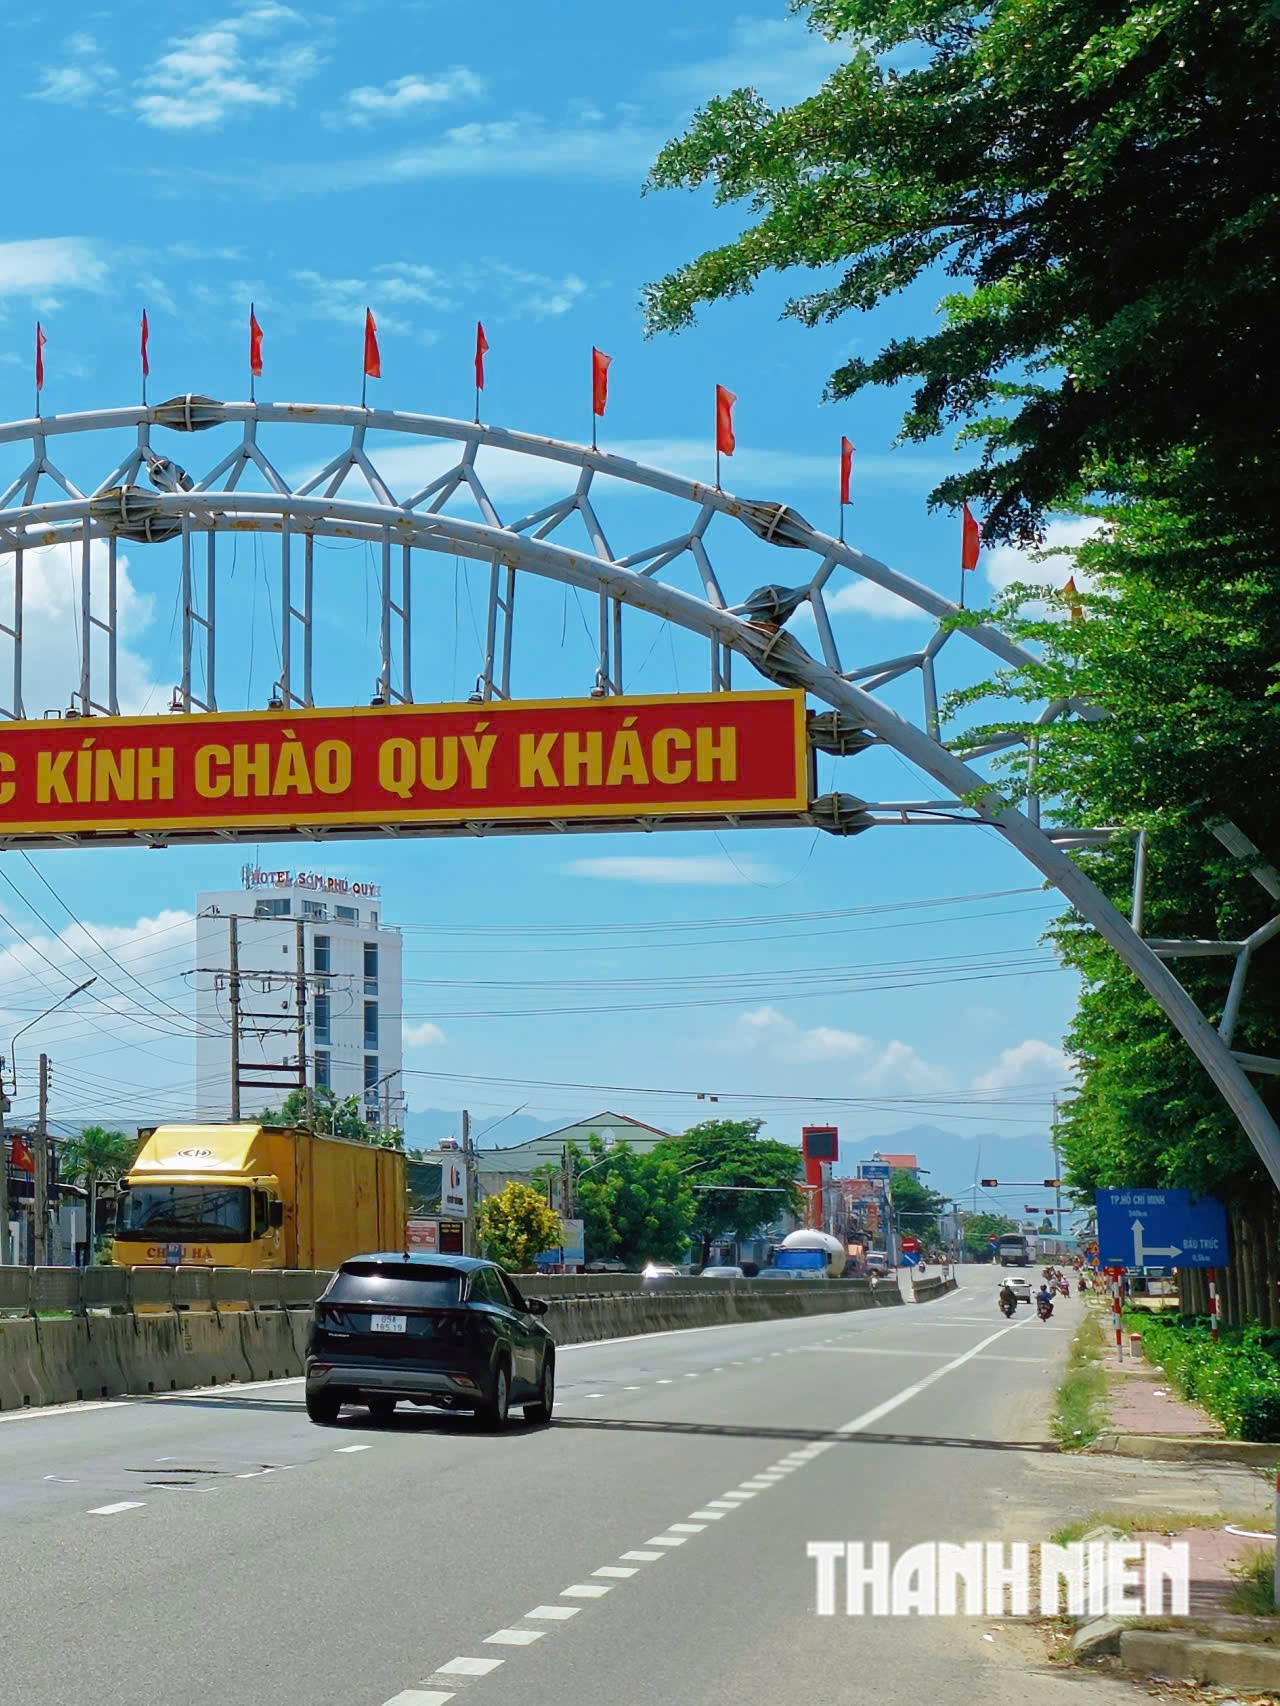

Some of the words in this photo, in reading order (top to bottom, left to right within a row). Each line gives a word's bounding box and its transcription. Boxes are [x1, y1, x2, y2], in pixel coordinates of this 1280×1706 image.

[37, 737, 175, 804] KÍNH
[195, 728, 352, 798] CHÀO
[379, 721, 498, 798] QUÝ
[520, 716, 738, 787] KHÁCH
[252, 870, 292, 885] HOTEL
[327, 876, 349, 892] PHÚ
